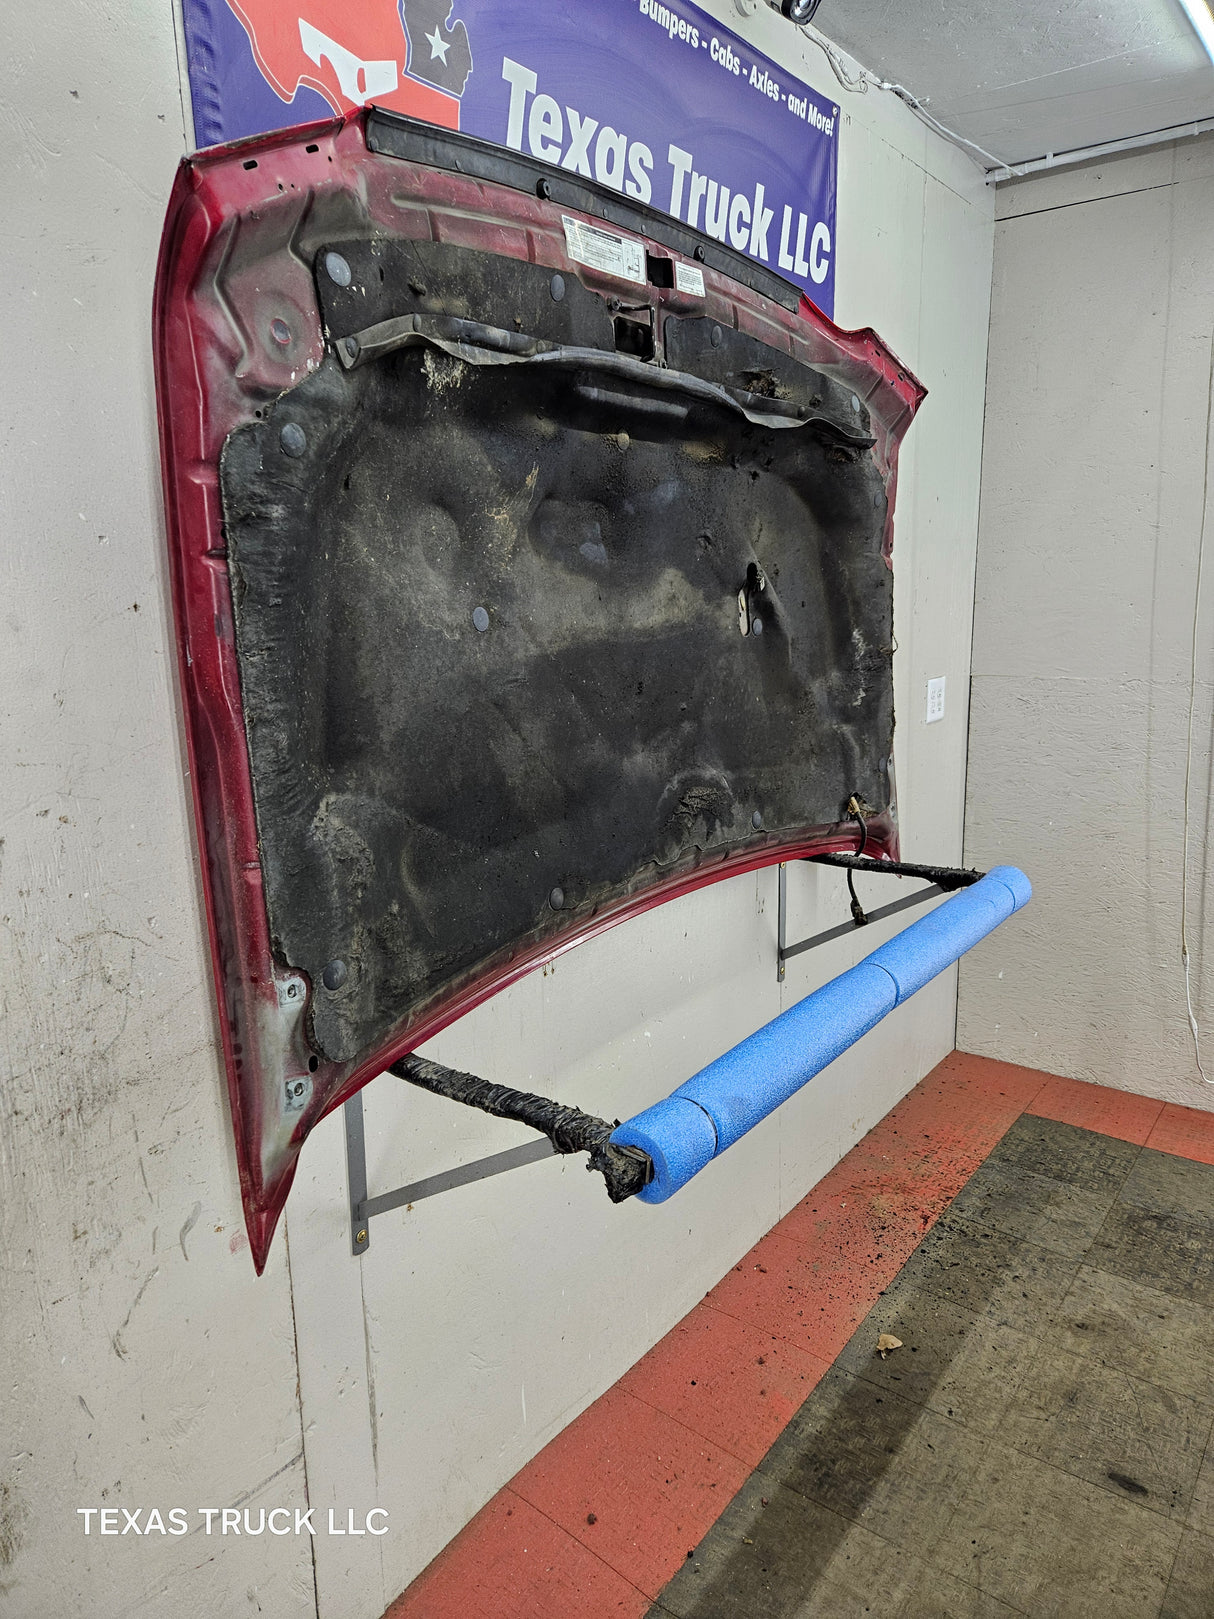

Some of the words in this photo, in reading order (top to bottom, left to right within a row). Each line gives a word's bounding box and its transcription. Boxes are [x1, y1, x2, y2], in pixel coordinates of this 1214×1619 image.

[639, 0, 699, 48] Bumpers
[710, 37, 740, 76] Cabs
[749, 64, 780, 102] Axles
[787, 93, 808, 120] and
[807, 103, 835, 137] More!
[502, 56, 654, 205] Texas
[667, 143, 775, 262] Truck
[777, 204, 831, 285] LLC
